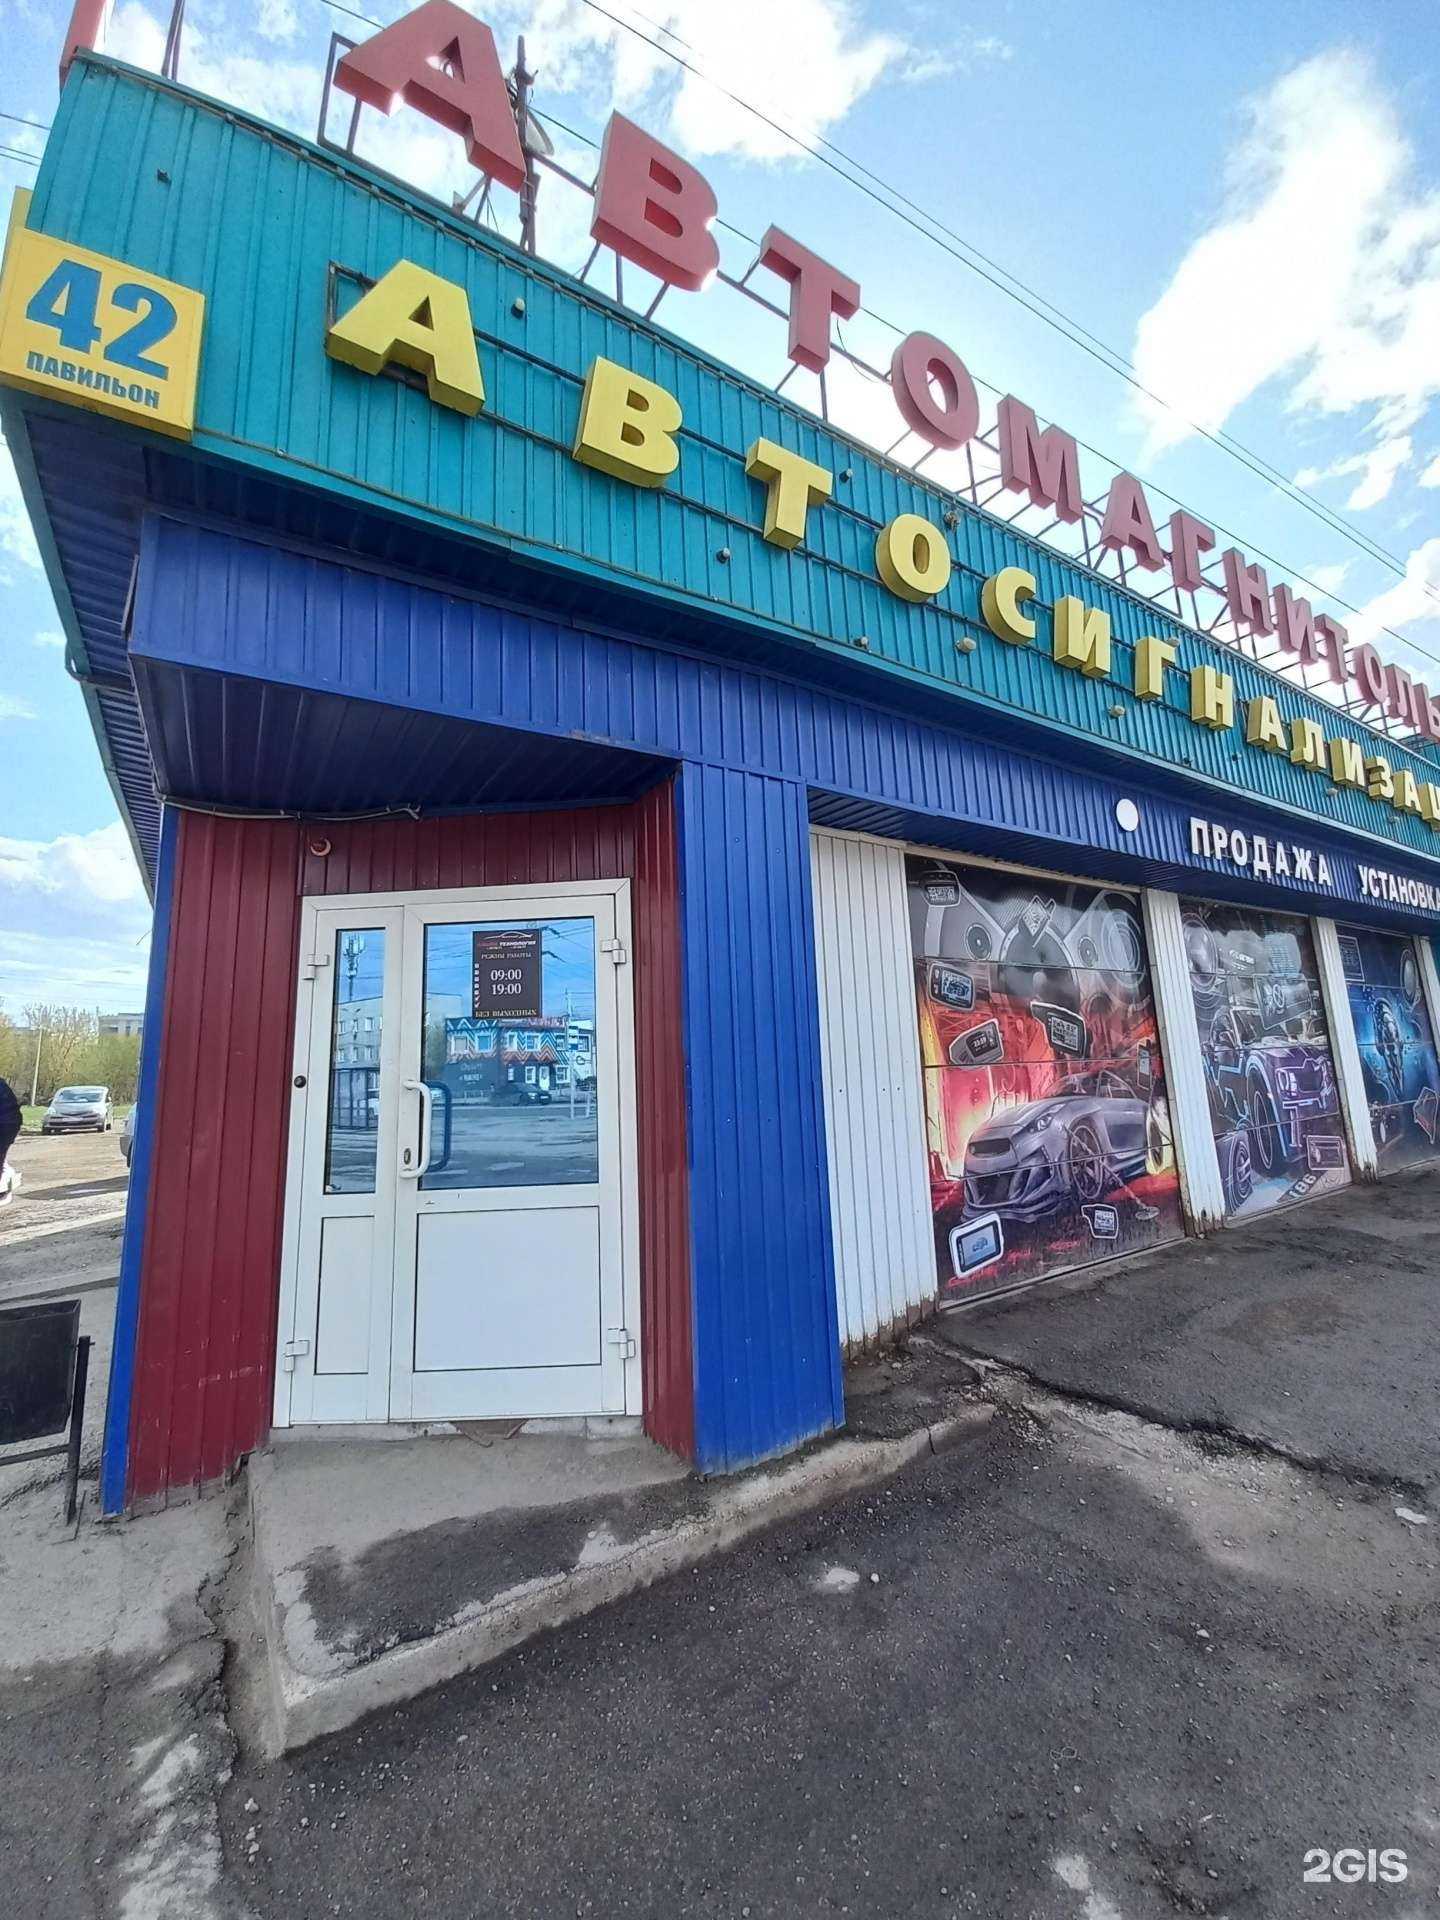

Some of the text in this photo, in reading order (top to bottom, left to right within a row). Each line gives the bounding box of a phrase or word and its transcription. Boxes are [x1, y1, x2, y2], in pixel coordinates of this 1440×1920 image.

[26, 259, 178, 381] 42
[26, 351, 160, 409] ПАВИЛЬОН
[1190, 816, 1332, 886] ПРОДАЖА
[490, 969, 522, 981] 09:00
[491, 983, 522, 995] 19:00
